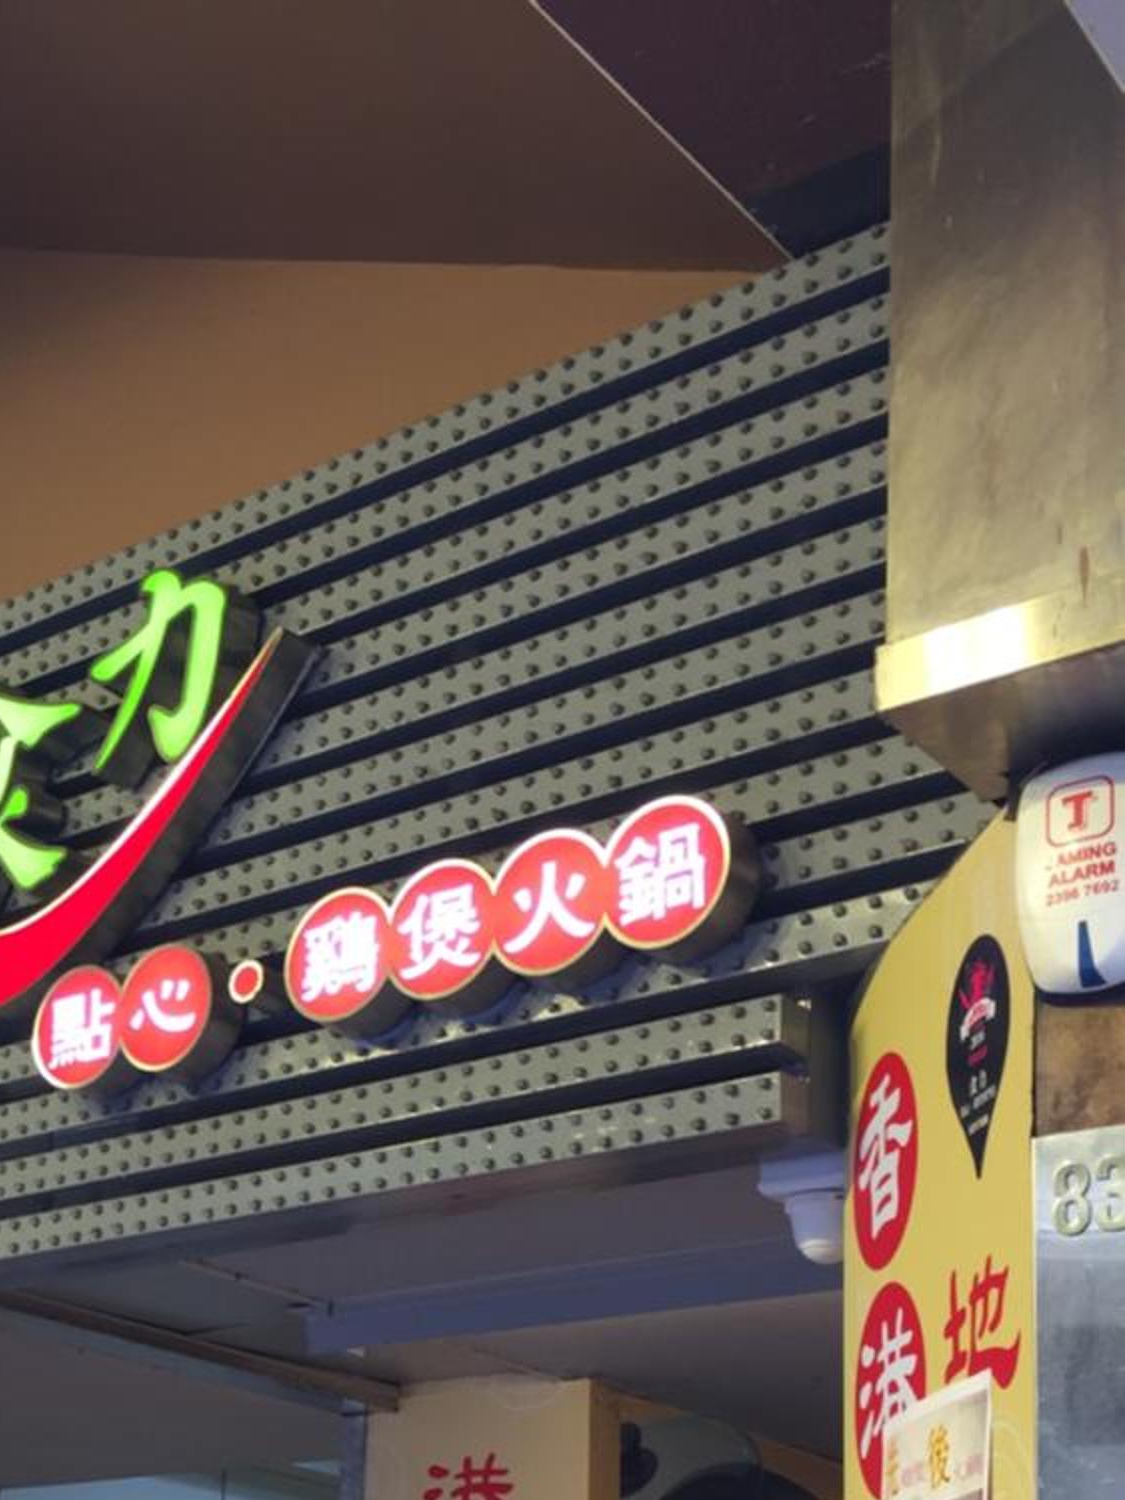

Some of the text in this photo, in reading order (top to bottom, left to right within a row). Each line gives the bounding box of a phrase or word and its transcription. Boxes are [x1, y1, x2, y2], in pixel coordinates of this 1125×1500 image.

[1045, 841, 1118, 871] AMING
[1048, 860, 1116, 888] ALARM
[49, 978, 197, 1070] 點心
